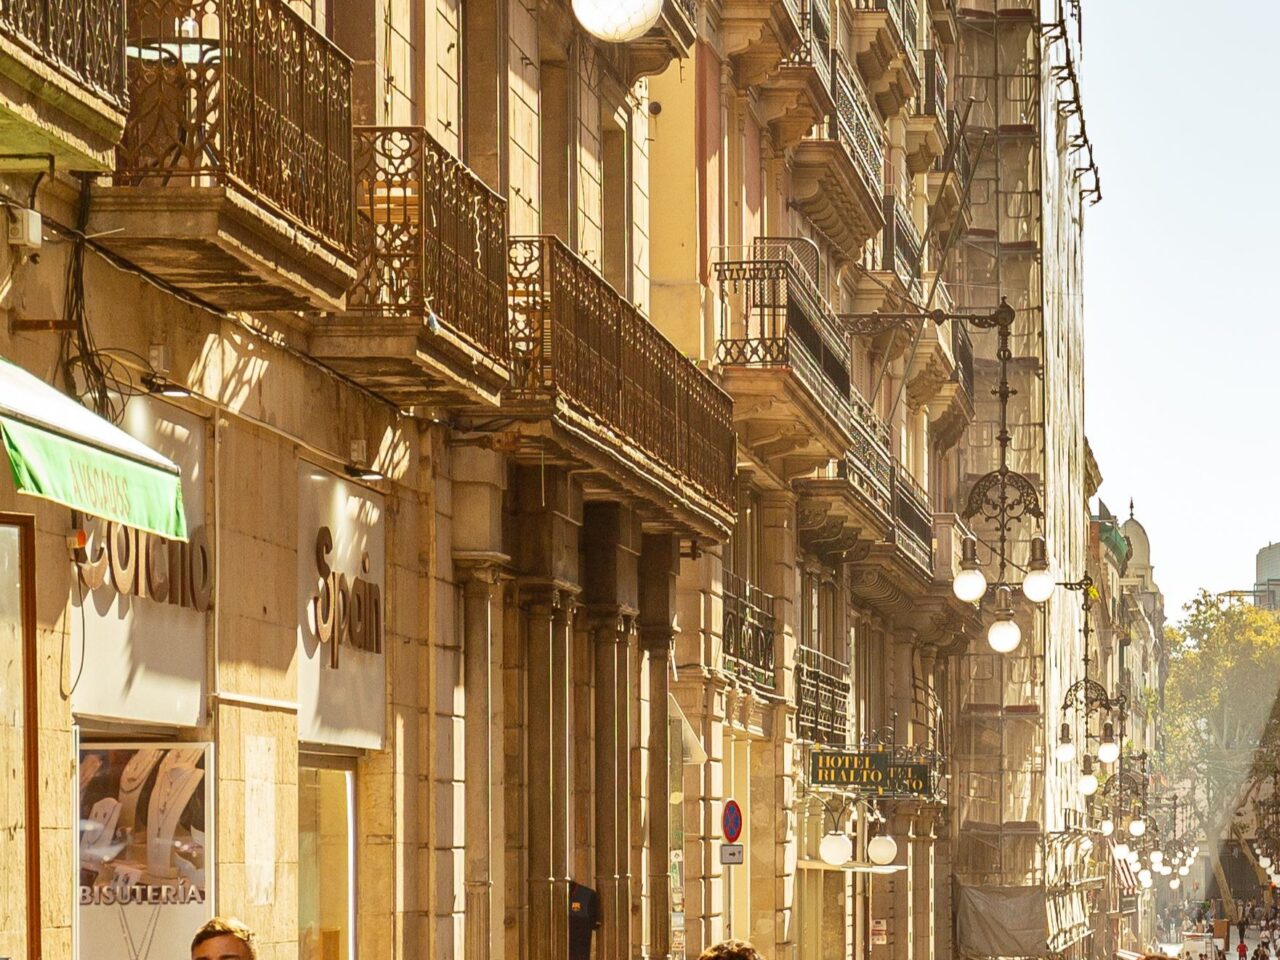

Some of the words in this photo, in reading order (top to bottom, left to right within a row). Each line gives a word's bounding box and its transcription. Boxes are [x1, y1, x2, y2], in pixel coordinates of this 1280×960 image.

[314, 526, 382, 669] Spain
[818, 755, 875, 769] HOTEL
[818, 769, 882, 783] RIALTO
[79, 878, 204, 906] BISUTERÍA
